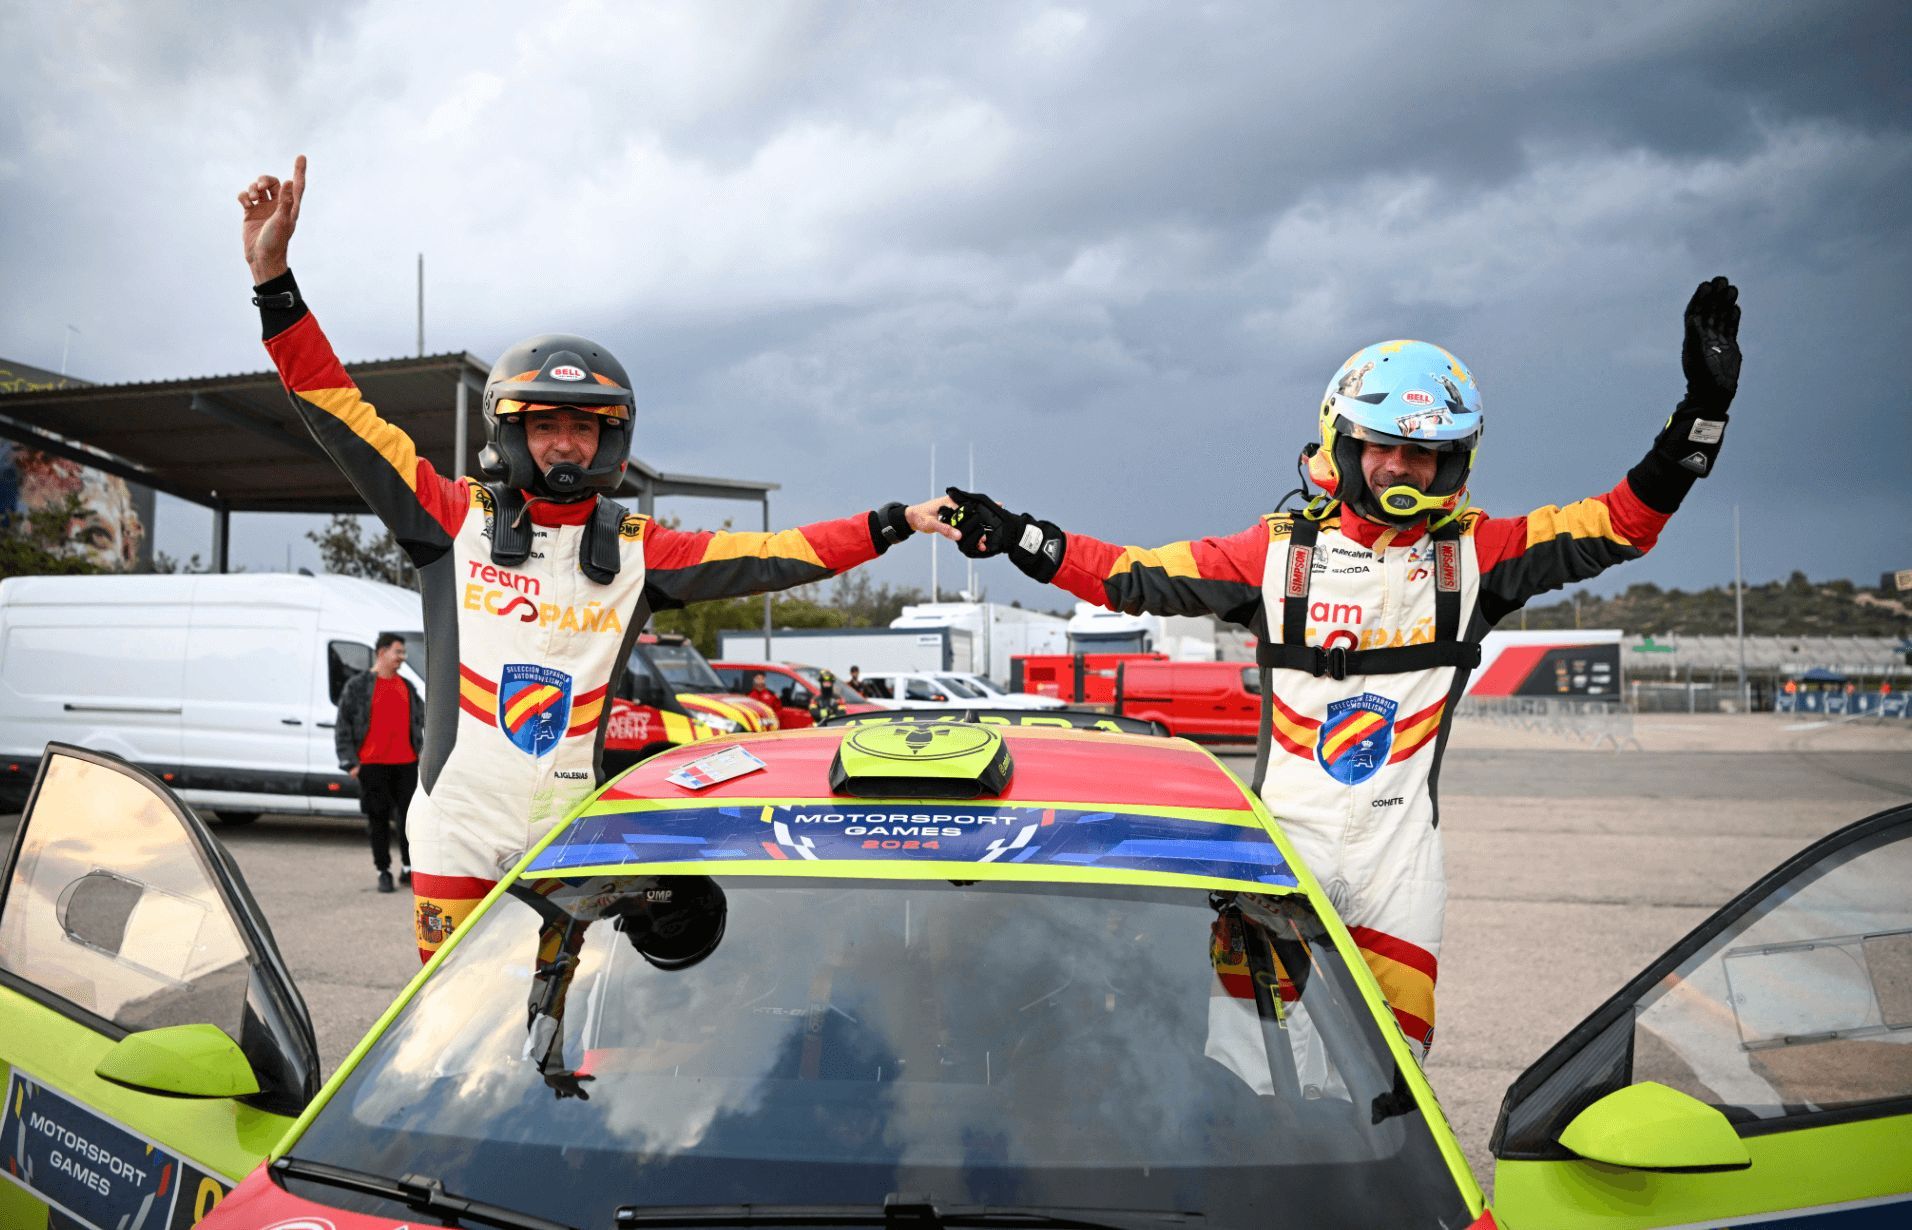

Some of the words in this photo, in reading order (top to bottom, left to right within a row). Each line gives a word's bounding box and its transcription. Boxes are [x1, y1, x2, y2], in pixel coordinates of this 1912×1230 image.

[554, 368, 580, 376] BELL
[1406, 393, 1430, 402] BELL
[1291, 550, 1306, 593] SIMPSON
[1442, 545, 1455, 587] SIMPSON
[795, 813, 1018, 826] MOTORSPORT
[844, 826, 962, 837] GAMES
[860, 840, 940, 849] 2024
[30, 1111, 148, 1188] MOTORSPORT
[50, 1150, 111, 1197] GAMES
